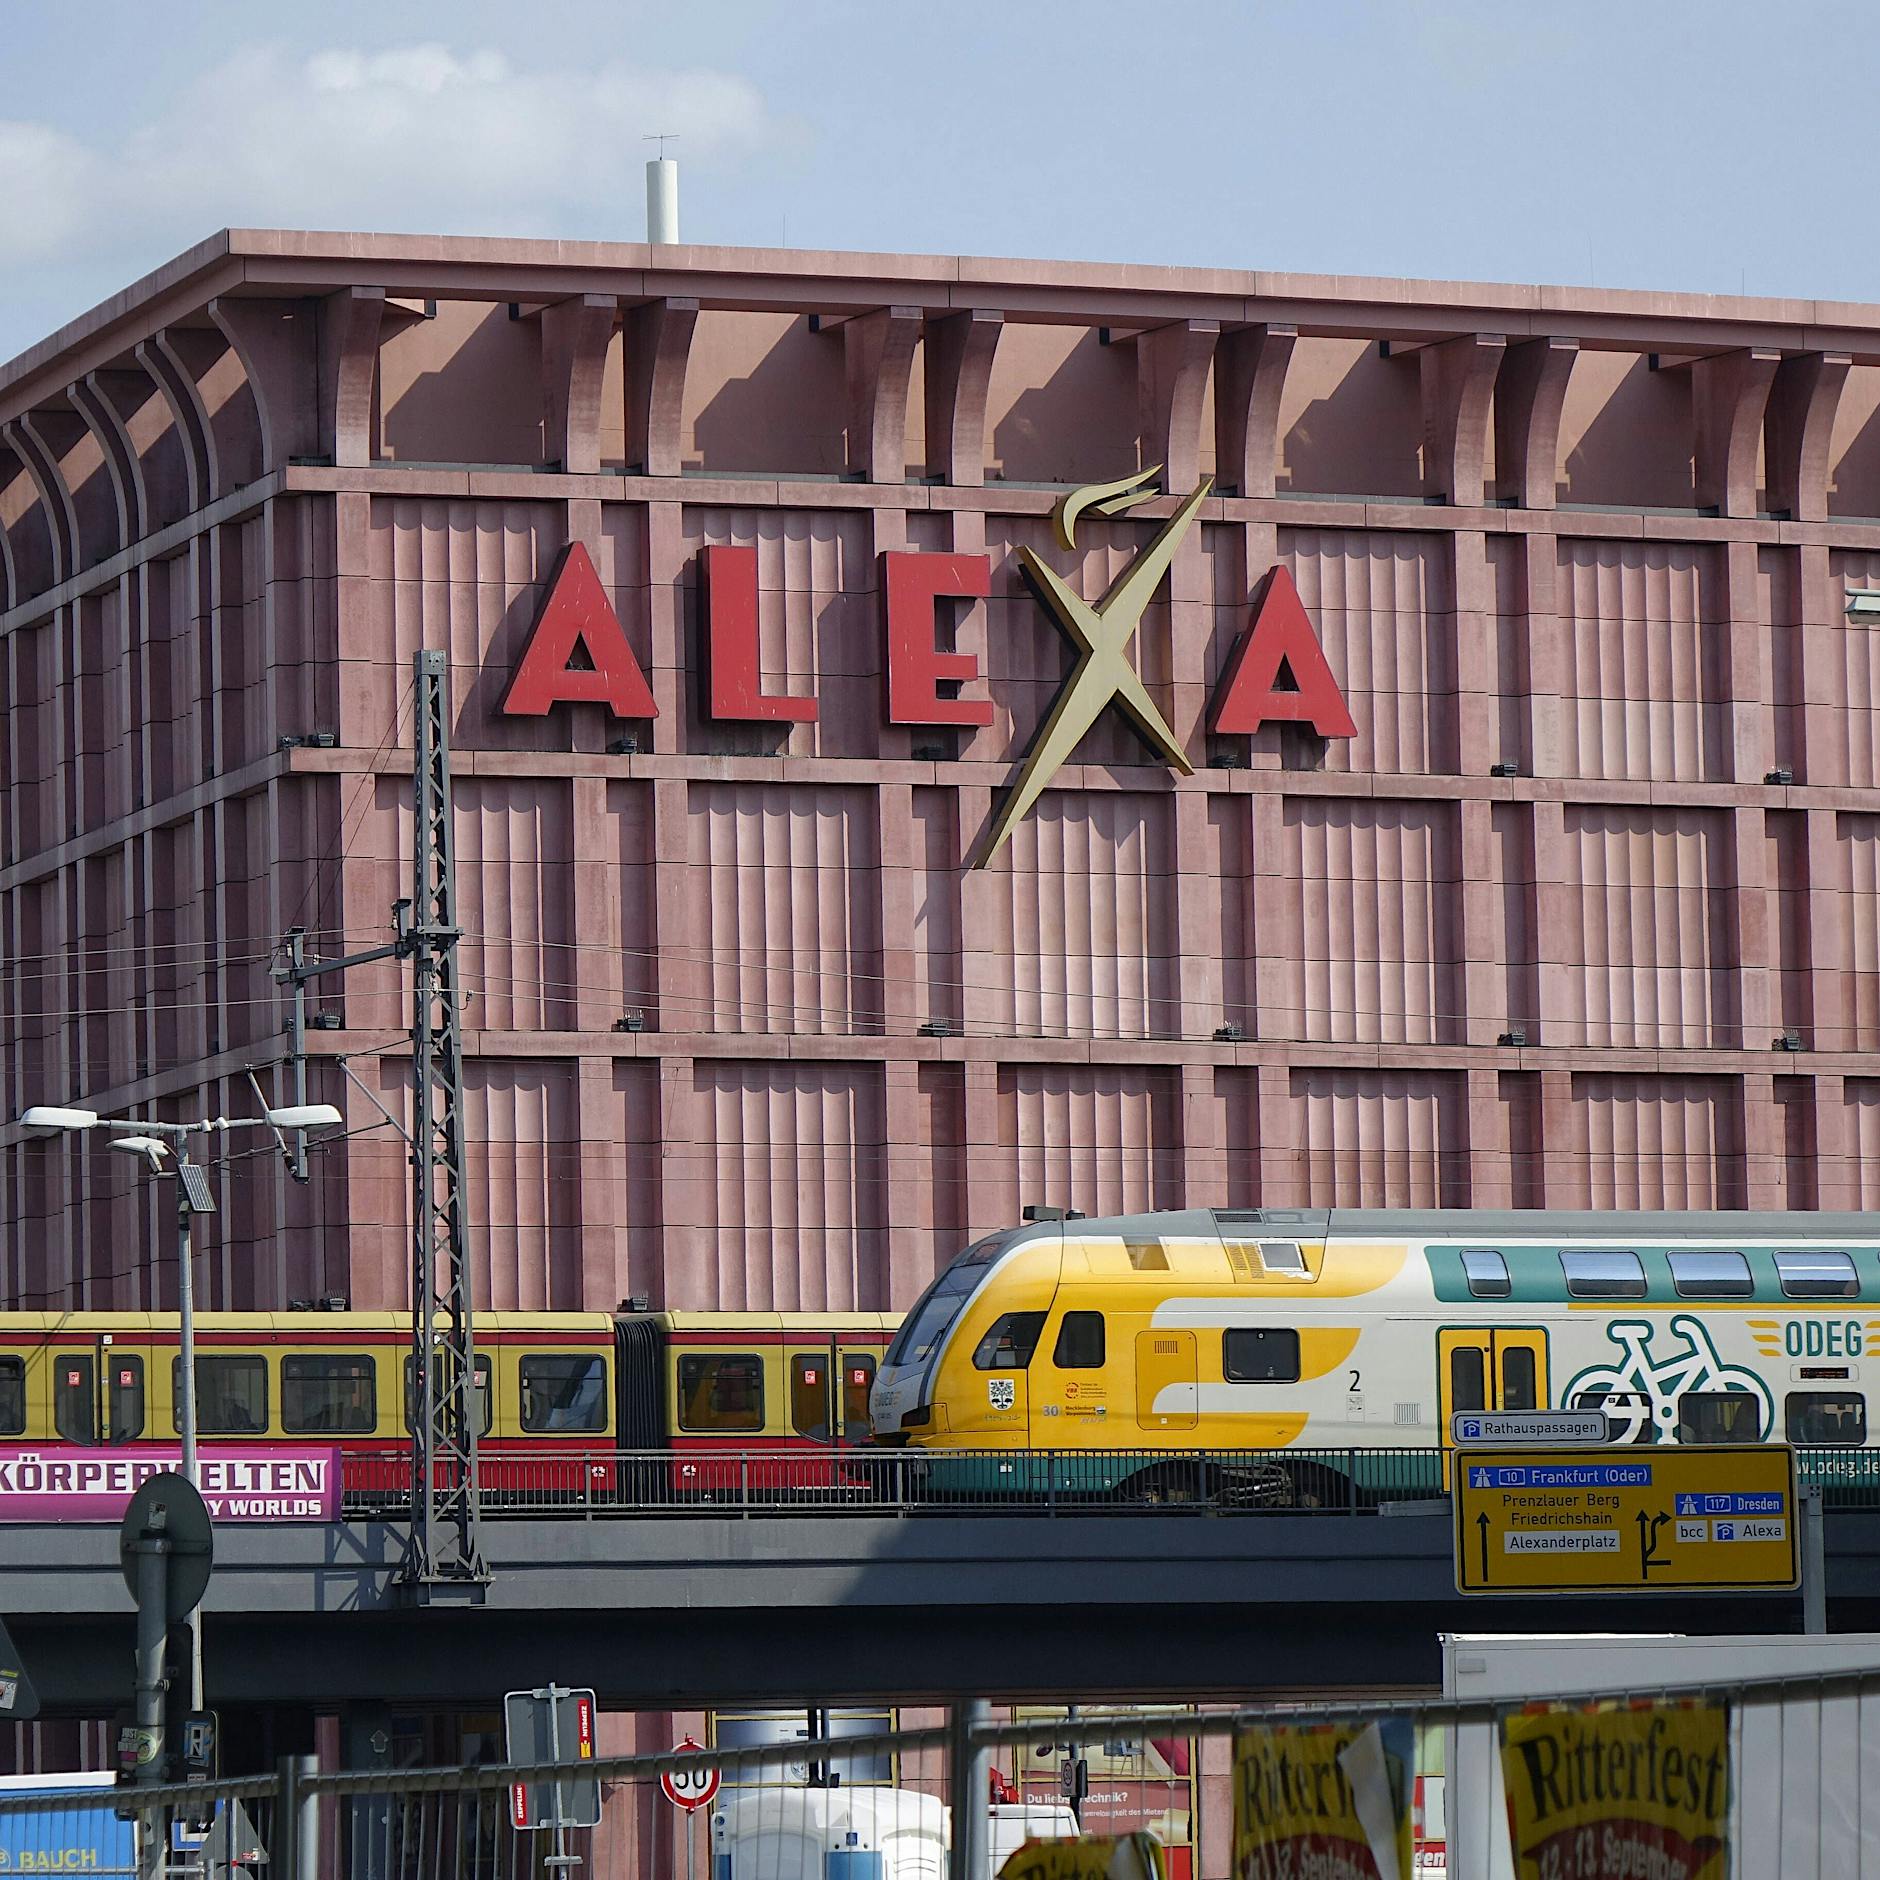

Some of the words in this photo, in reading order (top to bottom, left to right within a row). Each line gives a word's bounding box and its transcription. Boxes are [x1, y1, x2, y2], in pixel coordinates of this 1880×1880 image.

[502, 465, 1358, 868] ALEXA
[1786, 1320, 1862, 1357] ODEG
[1349, 1369, 1361, 1392] 2
[1485, 1422, 1597, 1435] Rathauspassagen
[0, 1456, 321, 1491] KÖRPERELTEN
[1505, 1471, 1518, 1483] 10
[1531, 1469, 1599, 1484] Frankfurt
[1605, 1468, 1648, 1483] (Oder)
[228, 1499, 322, 1516] WORLDS
[1503, 1494, 1579, 1507] Prenzlauer
[1587, 1493, 1620, 1508] Berg
[1710, 1498, 1725, 1510] 117
[1737, 1497, 1780, 1511] Dresden
[1511, 1511, 1613, 1526] Friedrichshain
[1680, 1525, 1704, 1538] bcc
[1743, 1524, 1782, 1537] Alexa
[1510, 1535, 1616, 1551] Alexanderplatz
[1511, 1717, 1724, 1824] Ritterfest
[1026, 1793, 1042, 1804] Du
[1044, 1793, 1071, 1804] liebs
[1081, 1792, 1128, 1804] echnik?
[19, 1847, 97, 1869] BAUCH
